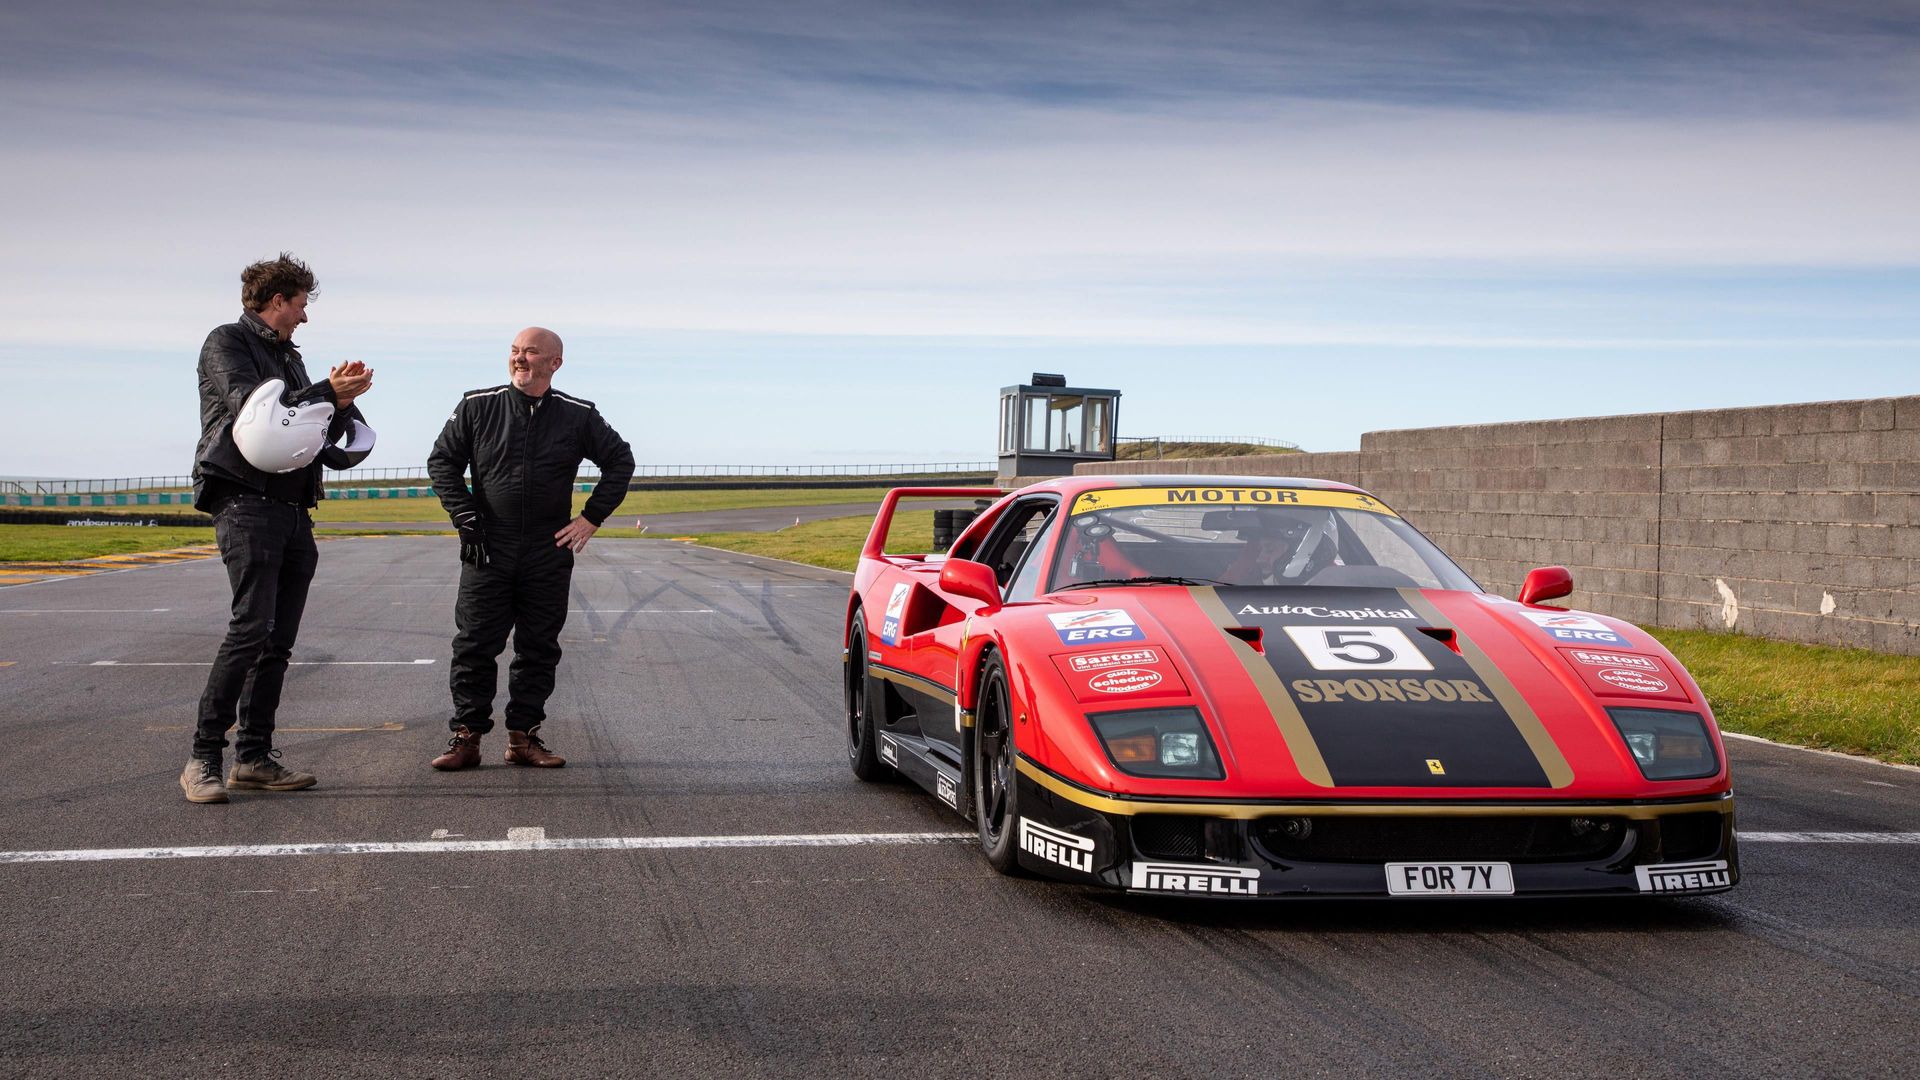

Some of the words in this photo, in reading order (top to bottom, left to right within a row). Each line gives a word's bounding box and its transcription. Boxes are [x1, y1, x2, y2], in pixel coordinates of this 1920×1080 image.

[1167, 489, 1299, 503] MOTOR
[1237, 604, 1418, 620] AutoCapital
[882, 620, 898, 638] ERG
[1067, 627, 1133, 641] ERG
[1554, 629, 1617, 642] ERG
[1322, 629, 1398, 665] 5
[1075, 651, 1152, 666] Sartori
[1577, 652, 1652, 666] Sartori
[1093, 673, 1159, 688] schedoni
[1106, 681, 1150, 693] modena
[1603, 675, 1664, 687] schedoni
[1292, 679, 1494, 703] SPONSOR
[1020, 815, 1095, 873] PIRELLI
[1132, 861, 1260, 895] PIRELLI
[1404, 866, 1456, 890] FOR
[1461, 866, 1492, 889] 7Y
[1635, 860, 1730, 891] PIRELLI
